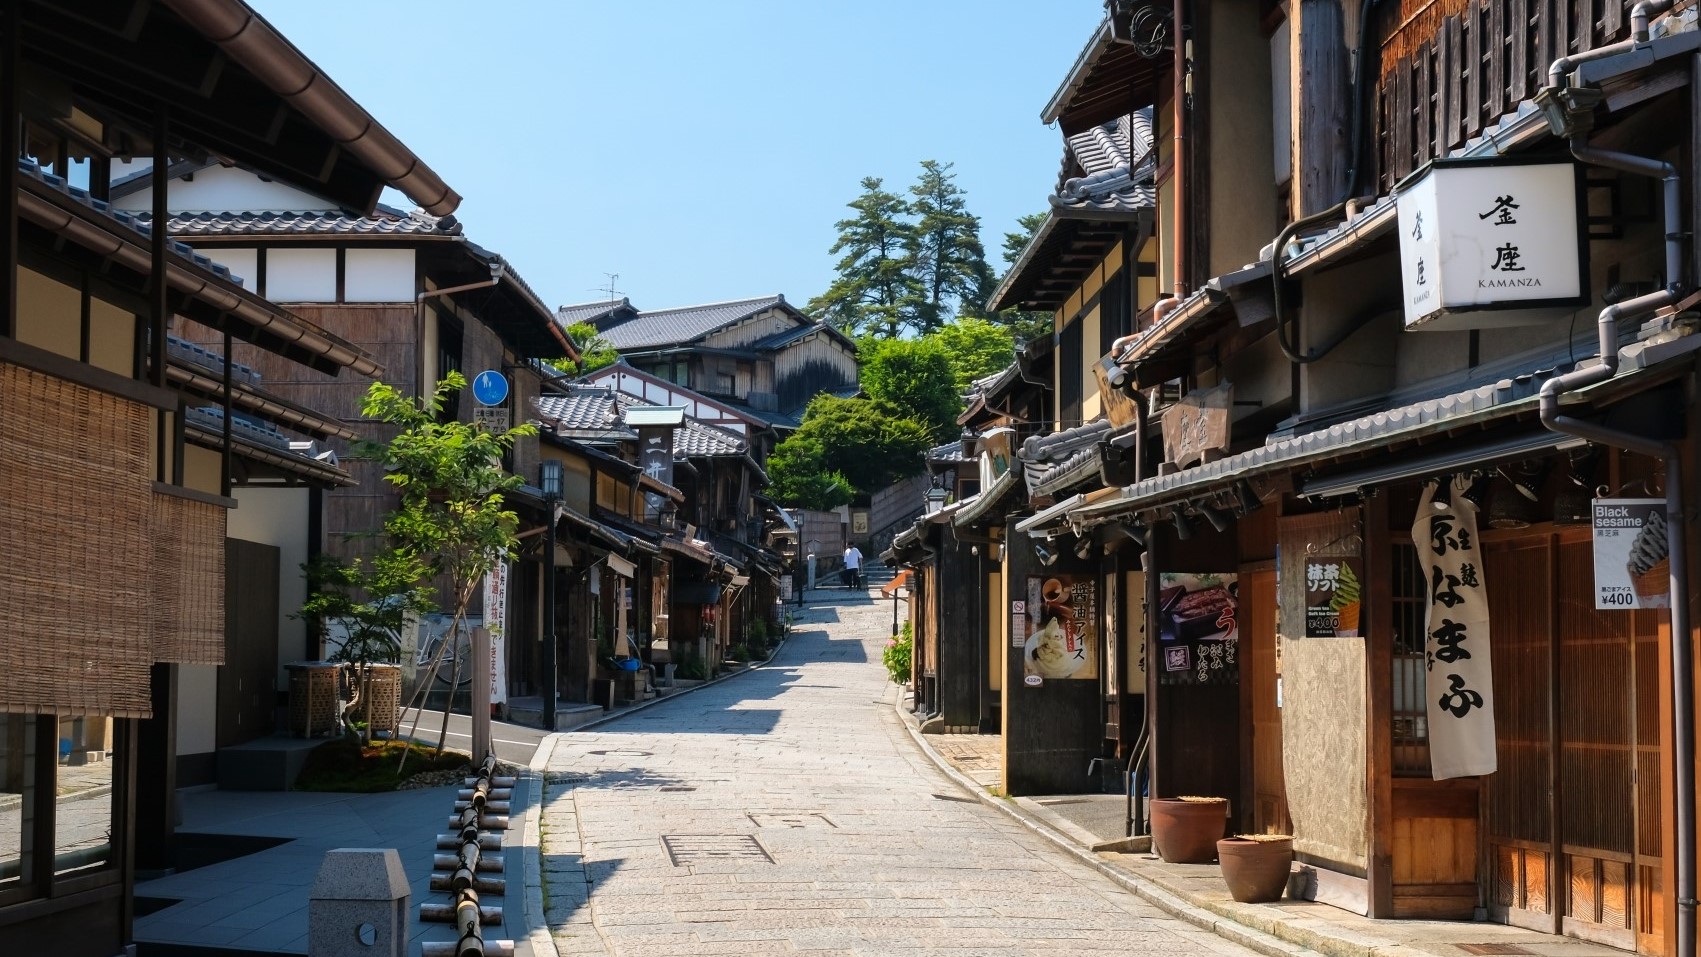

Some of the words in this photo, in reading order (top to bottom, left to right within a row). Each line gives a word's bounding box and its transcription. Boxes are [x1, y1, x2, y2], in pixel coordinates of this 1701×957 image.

[1479, 195, 1525, 272] 釜座
[1412, 211, 1426, 286] 釜座
[1478, 278, 1542, 288] KAMANZA
[1595, 506, 1628, 517] Black
[1595, 517, 1642, 527] sesame
[1307, 563, 1340, 580] 抹茶
[1307, 580, 1340, 592] ソフト
[1601, 593, 1633, 605] ¥400
[1071, 582, 1088, 660] 醤油アイス
[1308, 617, 1340, 629] ¥400
